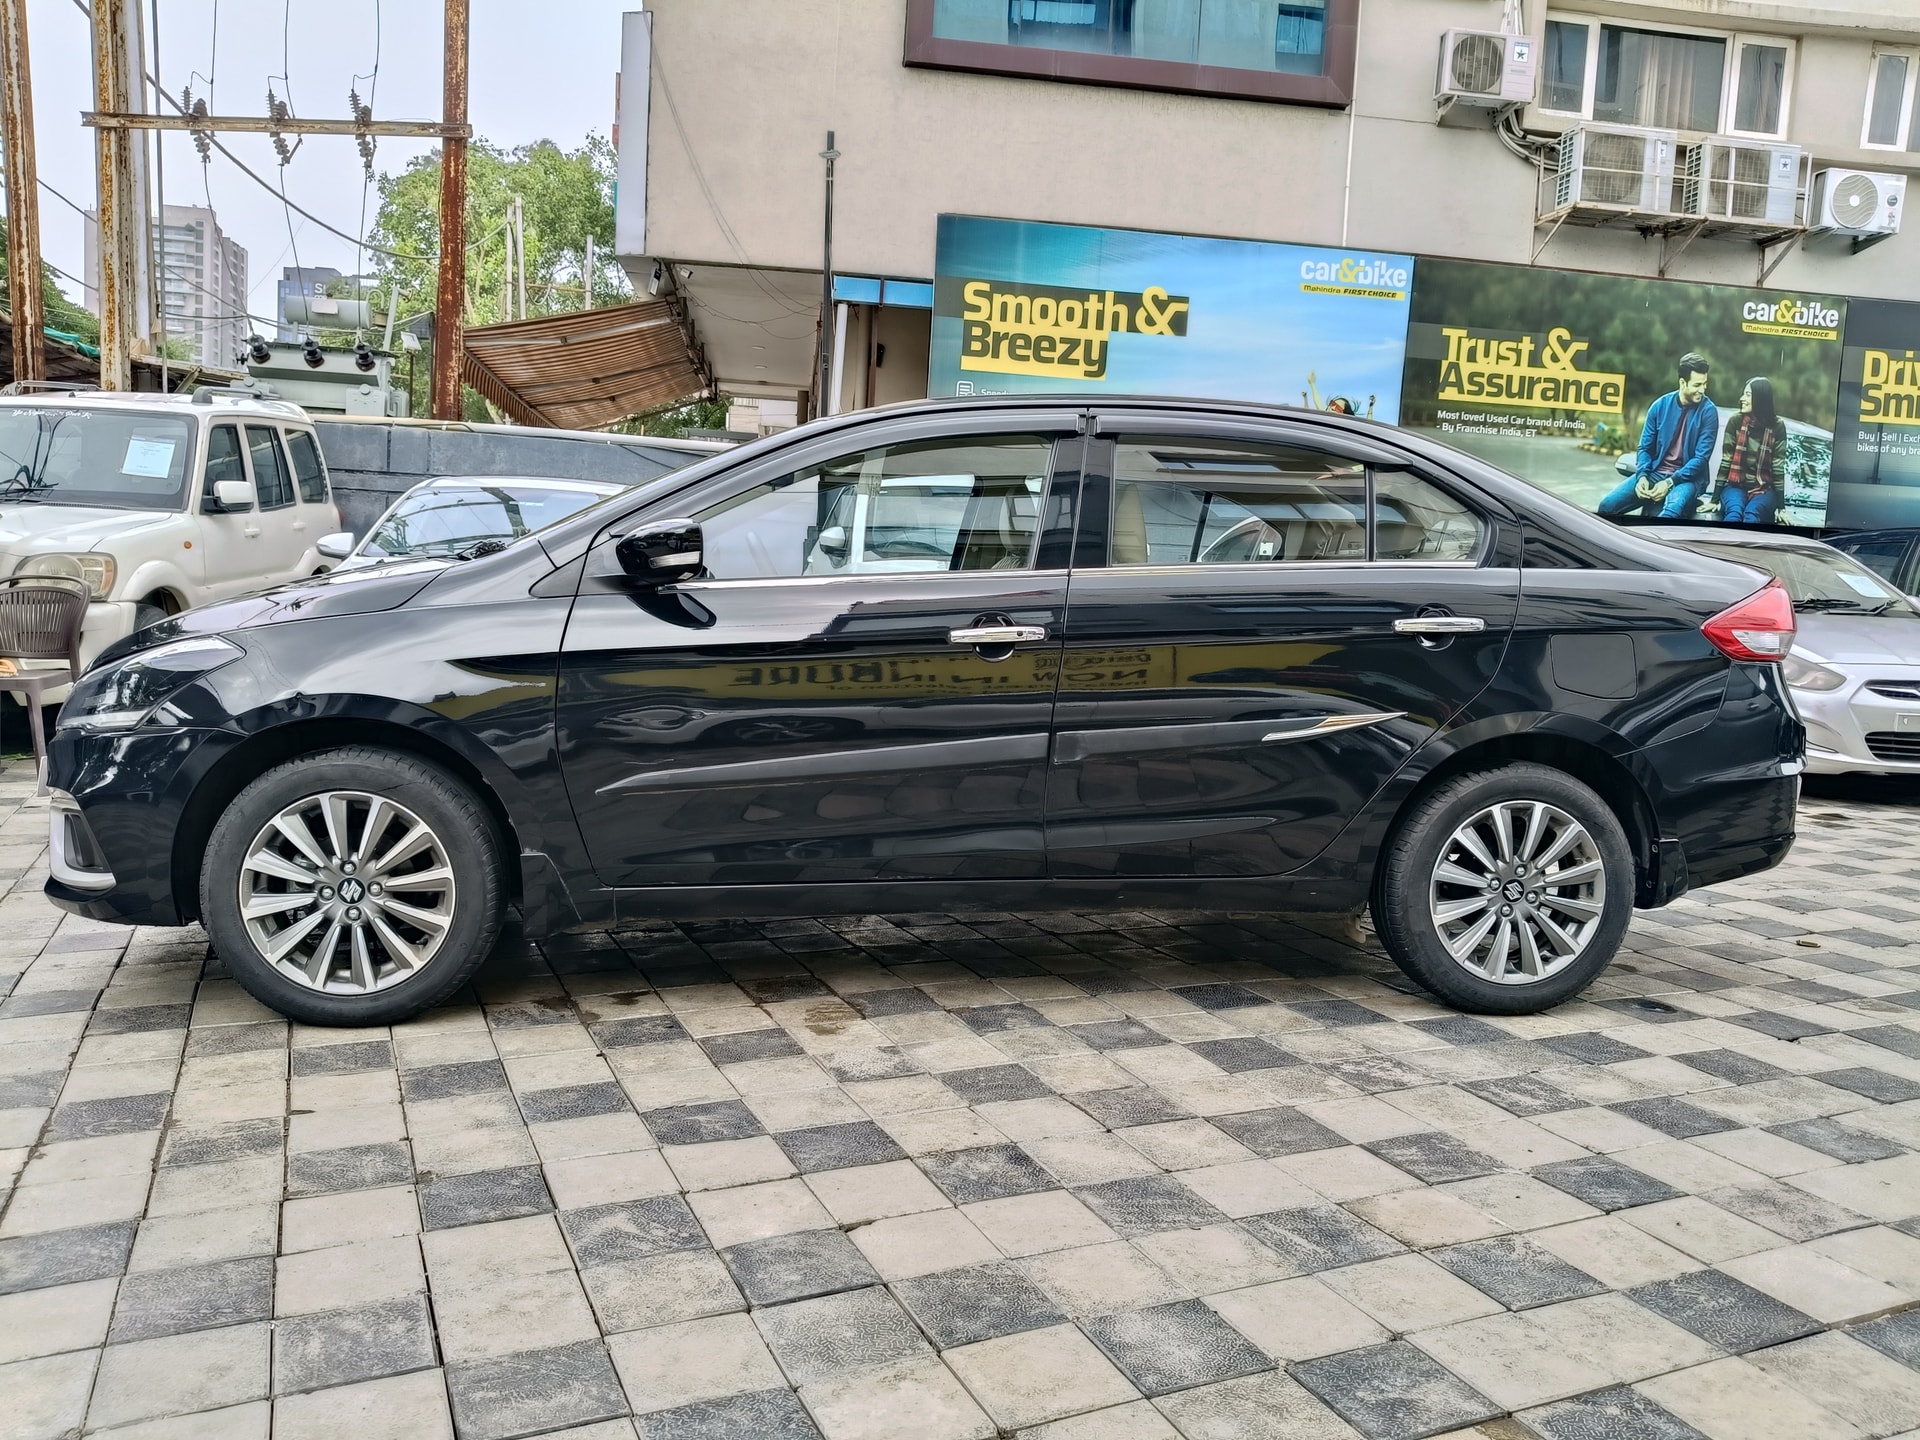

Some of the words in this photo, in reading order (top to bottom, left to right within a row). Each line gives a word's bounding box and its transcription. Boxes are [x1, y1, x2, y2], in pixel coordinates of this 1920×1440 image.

[1301, 258, 1407, 288] car&bike
[1303, 284, 1341, 294] Mahindra
[1343, 288, 1366, 296] FIRST
[1367, 290, 1397, 298] CHOICE
[963, 281, 1129, 333] Smooth
[1135, 286, 1189, 336] &
[1743, 299, 1839, 328] car&bike
[1745, 325, 1779, 333] Mahindra
[1803, 330, 1829, 338] CHOICE
[962, 319, 1108, 378] Breezy
[1442, 327, 1535, 368] Trust
[1541, 327, 1589, 370] &
[1438, 361, 1620, 406] Assurance
[1437, 410, 1459, 420] Most
[1461, 411, 1485, 422] loved
[1486, 414, 1509, 424] Used
[1510, 415, 1525, 425] Car
[1526, 416, 1552, 427] brand
[1553, 418, 1563, 428] of
[1564, 420, 1586, 430] India
[1442, 422, 1454, 433] By
[1456, 423, 1498, 436] Franchise
[1499, 427, 1524, 438] India,
[1525, 429, 1538, 438] ET
[1858, 431, 1875, 442] Buy
[1881, 432, 1897, 442] Sell
[1857, 442, 1879, 453] bikes
[1880, 444, 1890, 453] of
[1890, 446, 1907, 456] any
